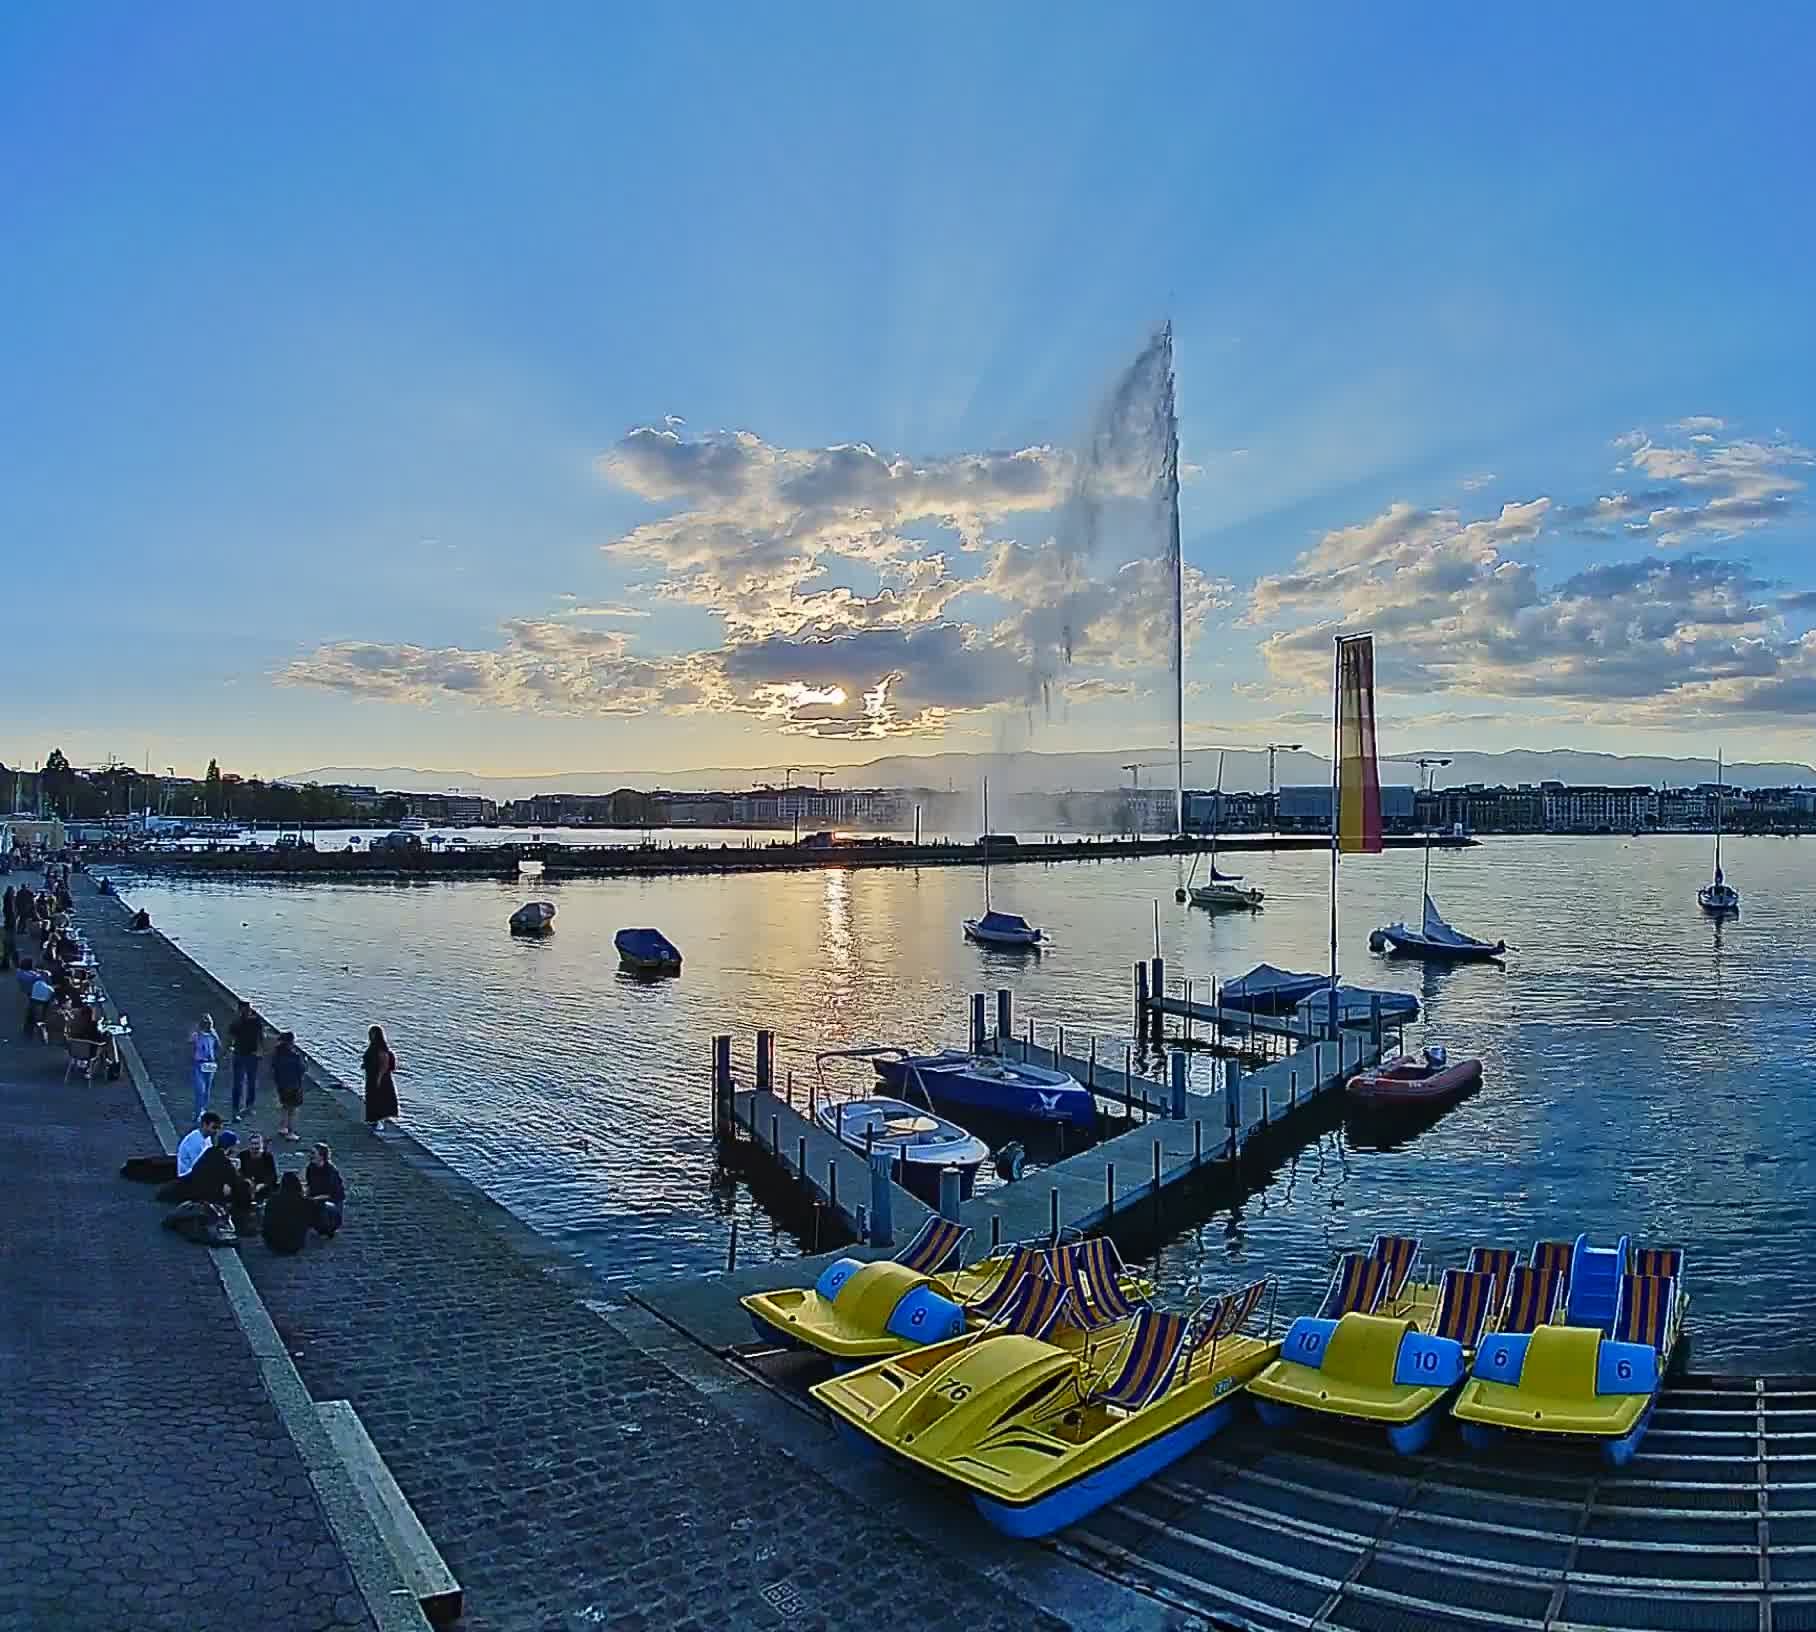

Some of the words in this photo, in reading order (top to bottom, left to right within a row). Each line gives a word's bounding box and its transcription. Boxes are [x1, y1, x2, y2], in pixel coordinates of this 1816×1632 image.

[831, 1271, 845, 1286] 8
[911, 1307, 927, 1326] 8
[1299, 1332, 1320, 1351] 10
[1413, 1351, 1438, 1372] 10
[1494, 1348, 1508, 1367] 6
[1617, 1359, 1632, 1379] 6
[936, 1377, 972, 1401] 76
